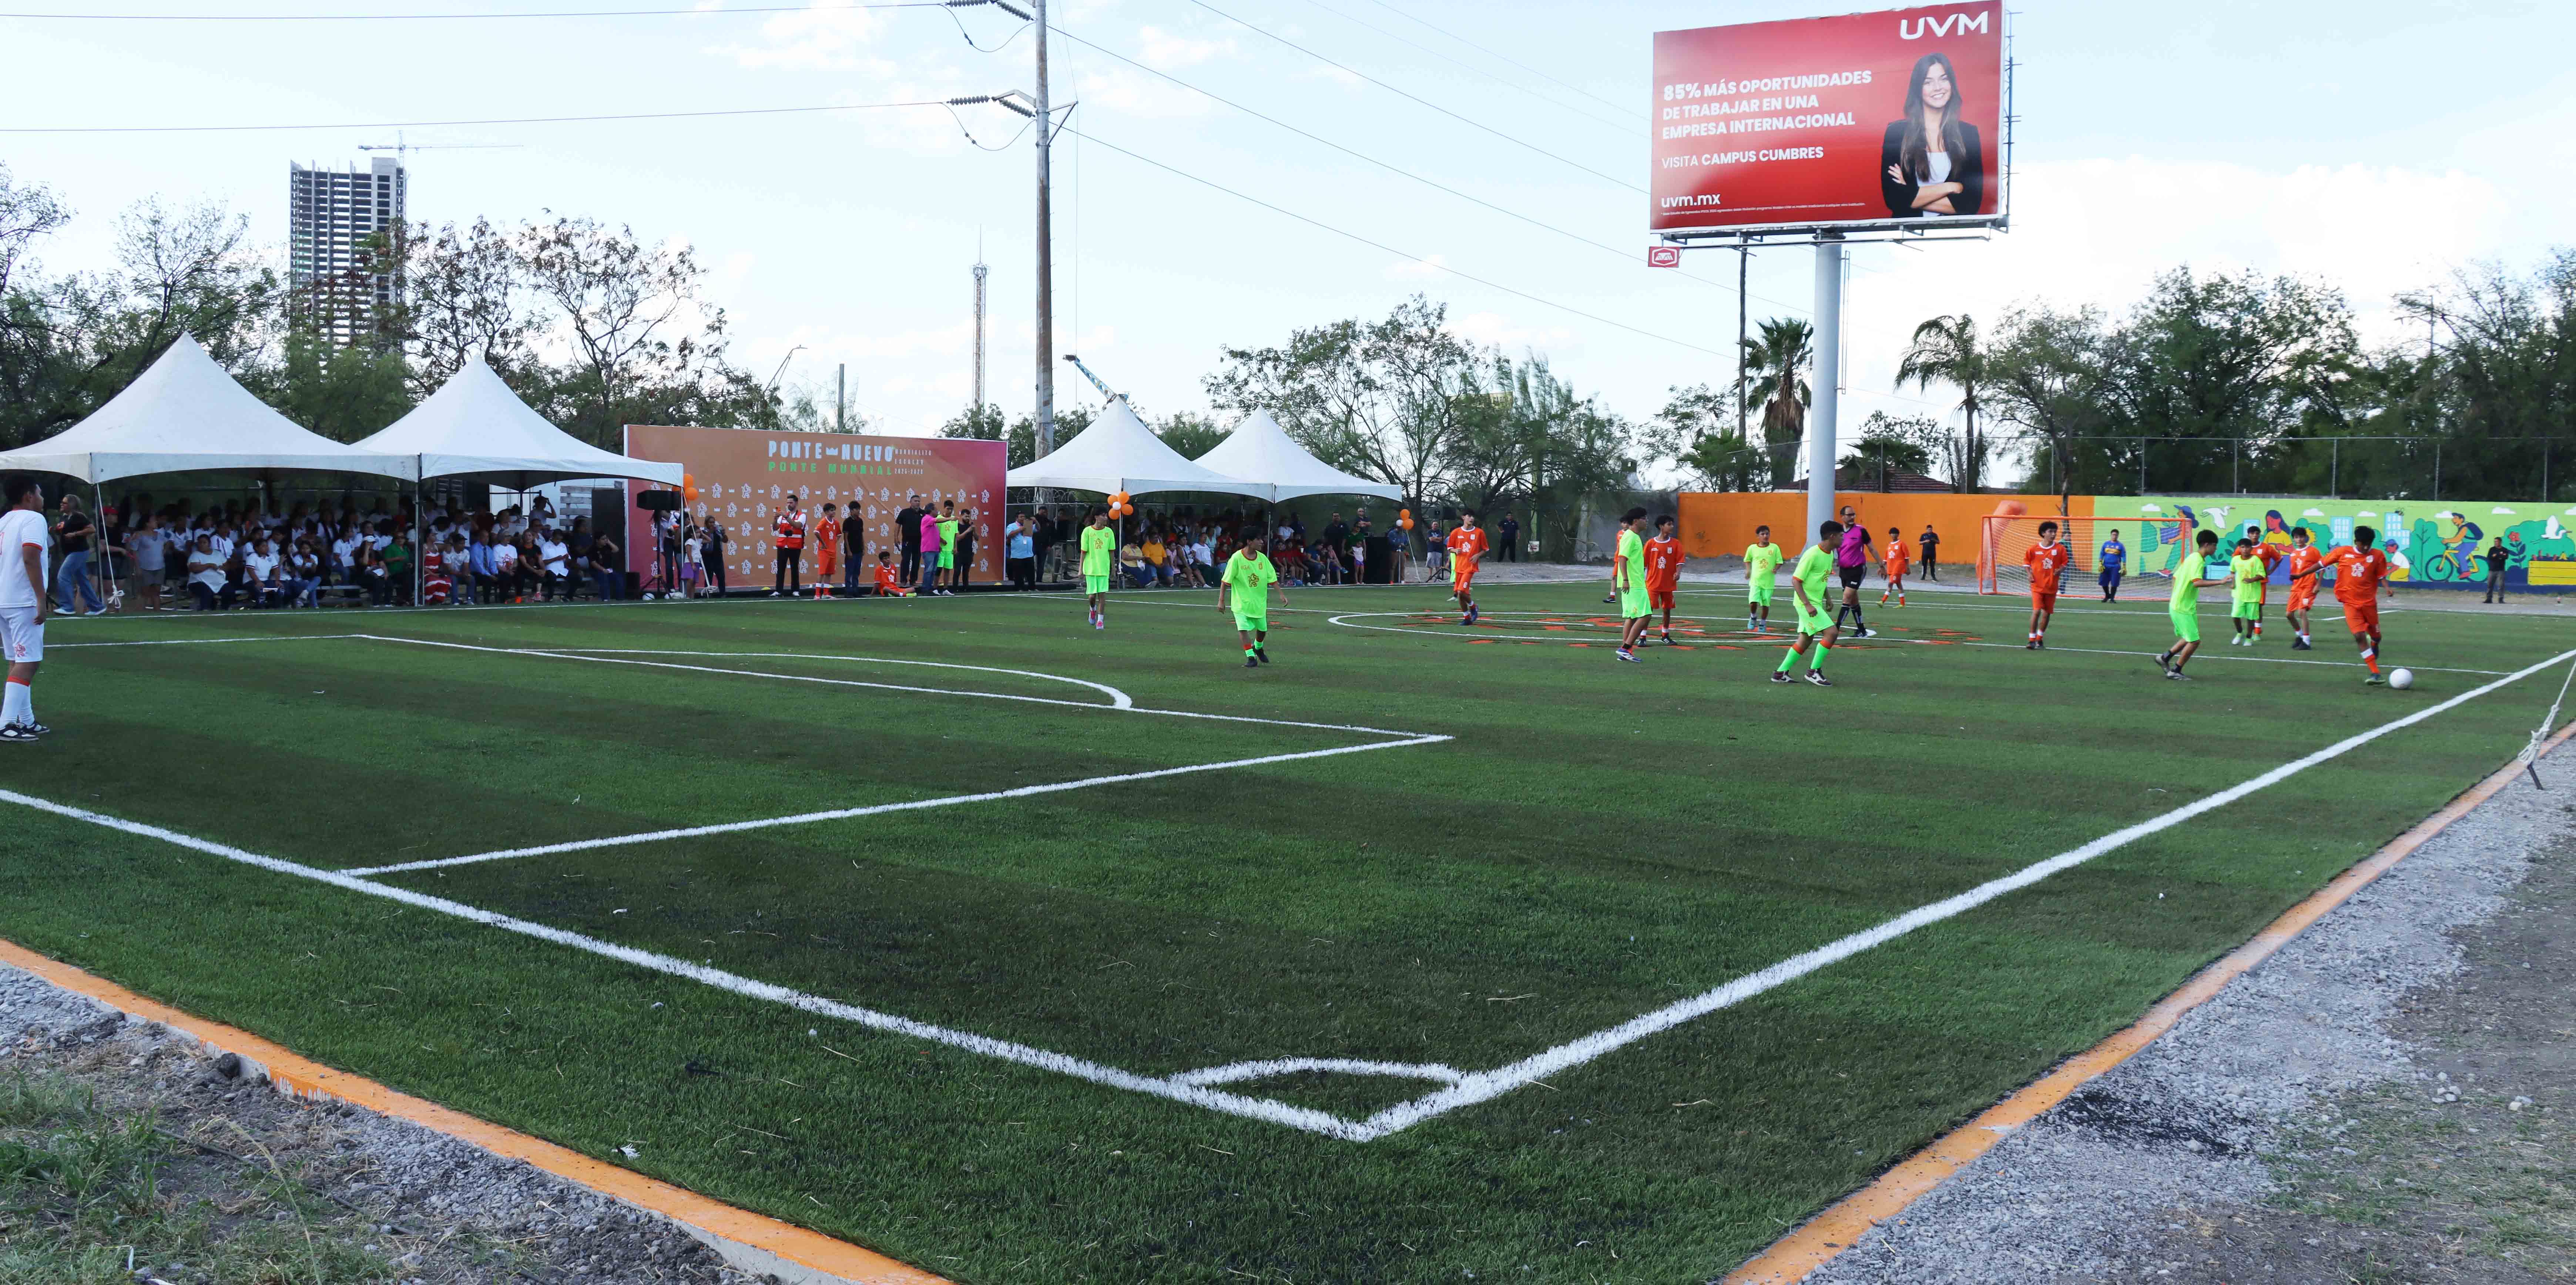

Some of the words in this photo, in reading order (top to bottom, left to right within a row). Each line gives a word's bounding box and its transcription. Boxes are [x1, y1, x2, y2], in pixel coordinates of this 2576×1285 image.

[1900, 11, 1988, 40] UVM
[1664, 83, 1701, 101] 85%
[1704, 78, 1737, 97] MÁS
[1739, 70, 1872, 93] OPORTUNIDADES
[1663, 107, 1680, 120] DE
[1683, 99, 1760, 119] TRABAJAR
[1762, 97, 1782, 111] EN
[1785, 94, 1819, 109] UNA
[1663, 121, 1727, 140] EMPRESA
[1730, 112, 1856, 134] INTERNACIONAL
[1661, 155, 1698, 169] VISITA
[1701, 150, 1757, 166] CAMPUS
[1759, 146, 1824, 161] CUMBRES
[1661, 194, 1721, 208] uvm.mx
[768, 440, 822, 459] PONTE
[841, 444, 893, 462] NUEVO
[768, 462, 817, 473] PONTE
[828, 463, 892, 475] MUNDIAL
